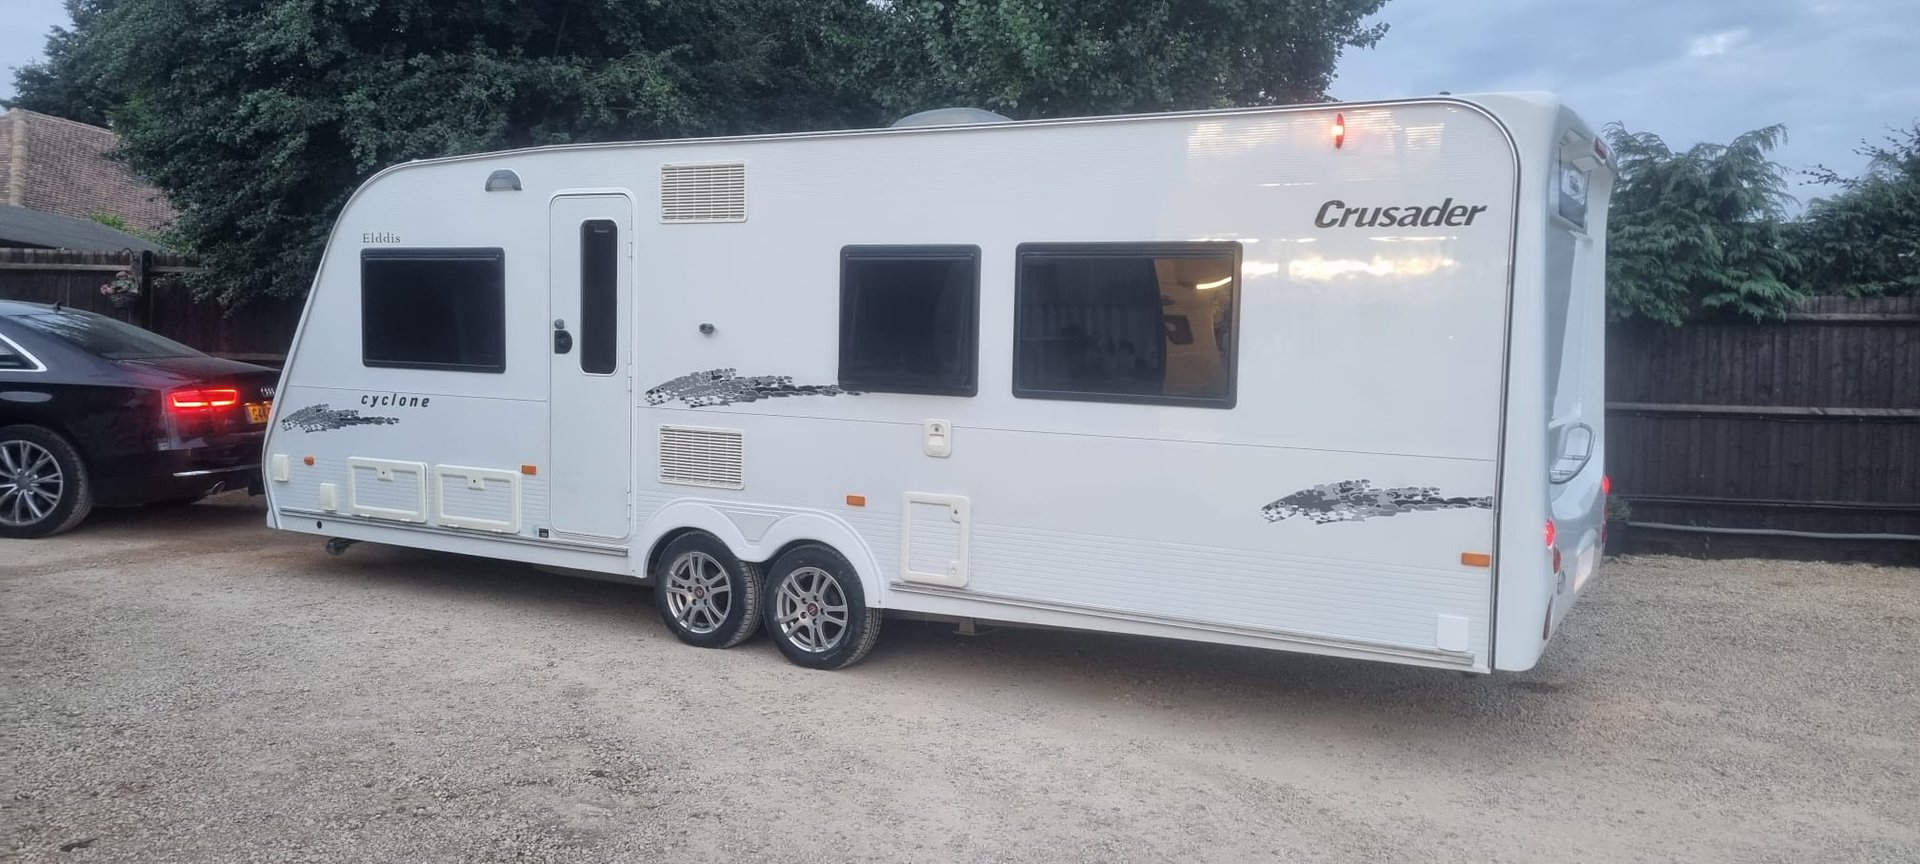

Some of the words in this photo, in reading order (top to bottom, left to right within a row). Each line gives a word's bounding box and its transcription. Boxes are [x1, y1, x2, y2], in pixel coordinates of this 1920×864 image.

[1314, 198, 1488, 229] Crusader
[363, 232, 401, 244] Elddis
[361, 393, 430, 408] cyclone
